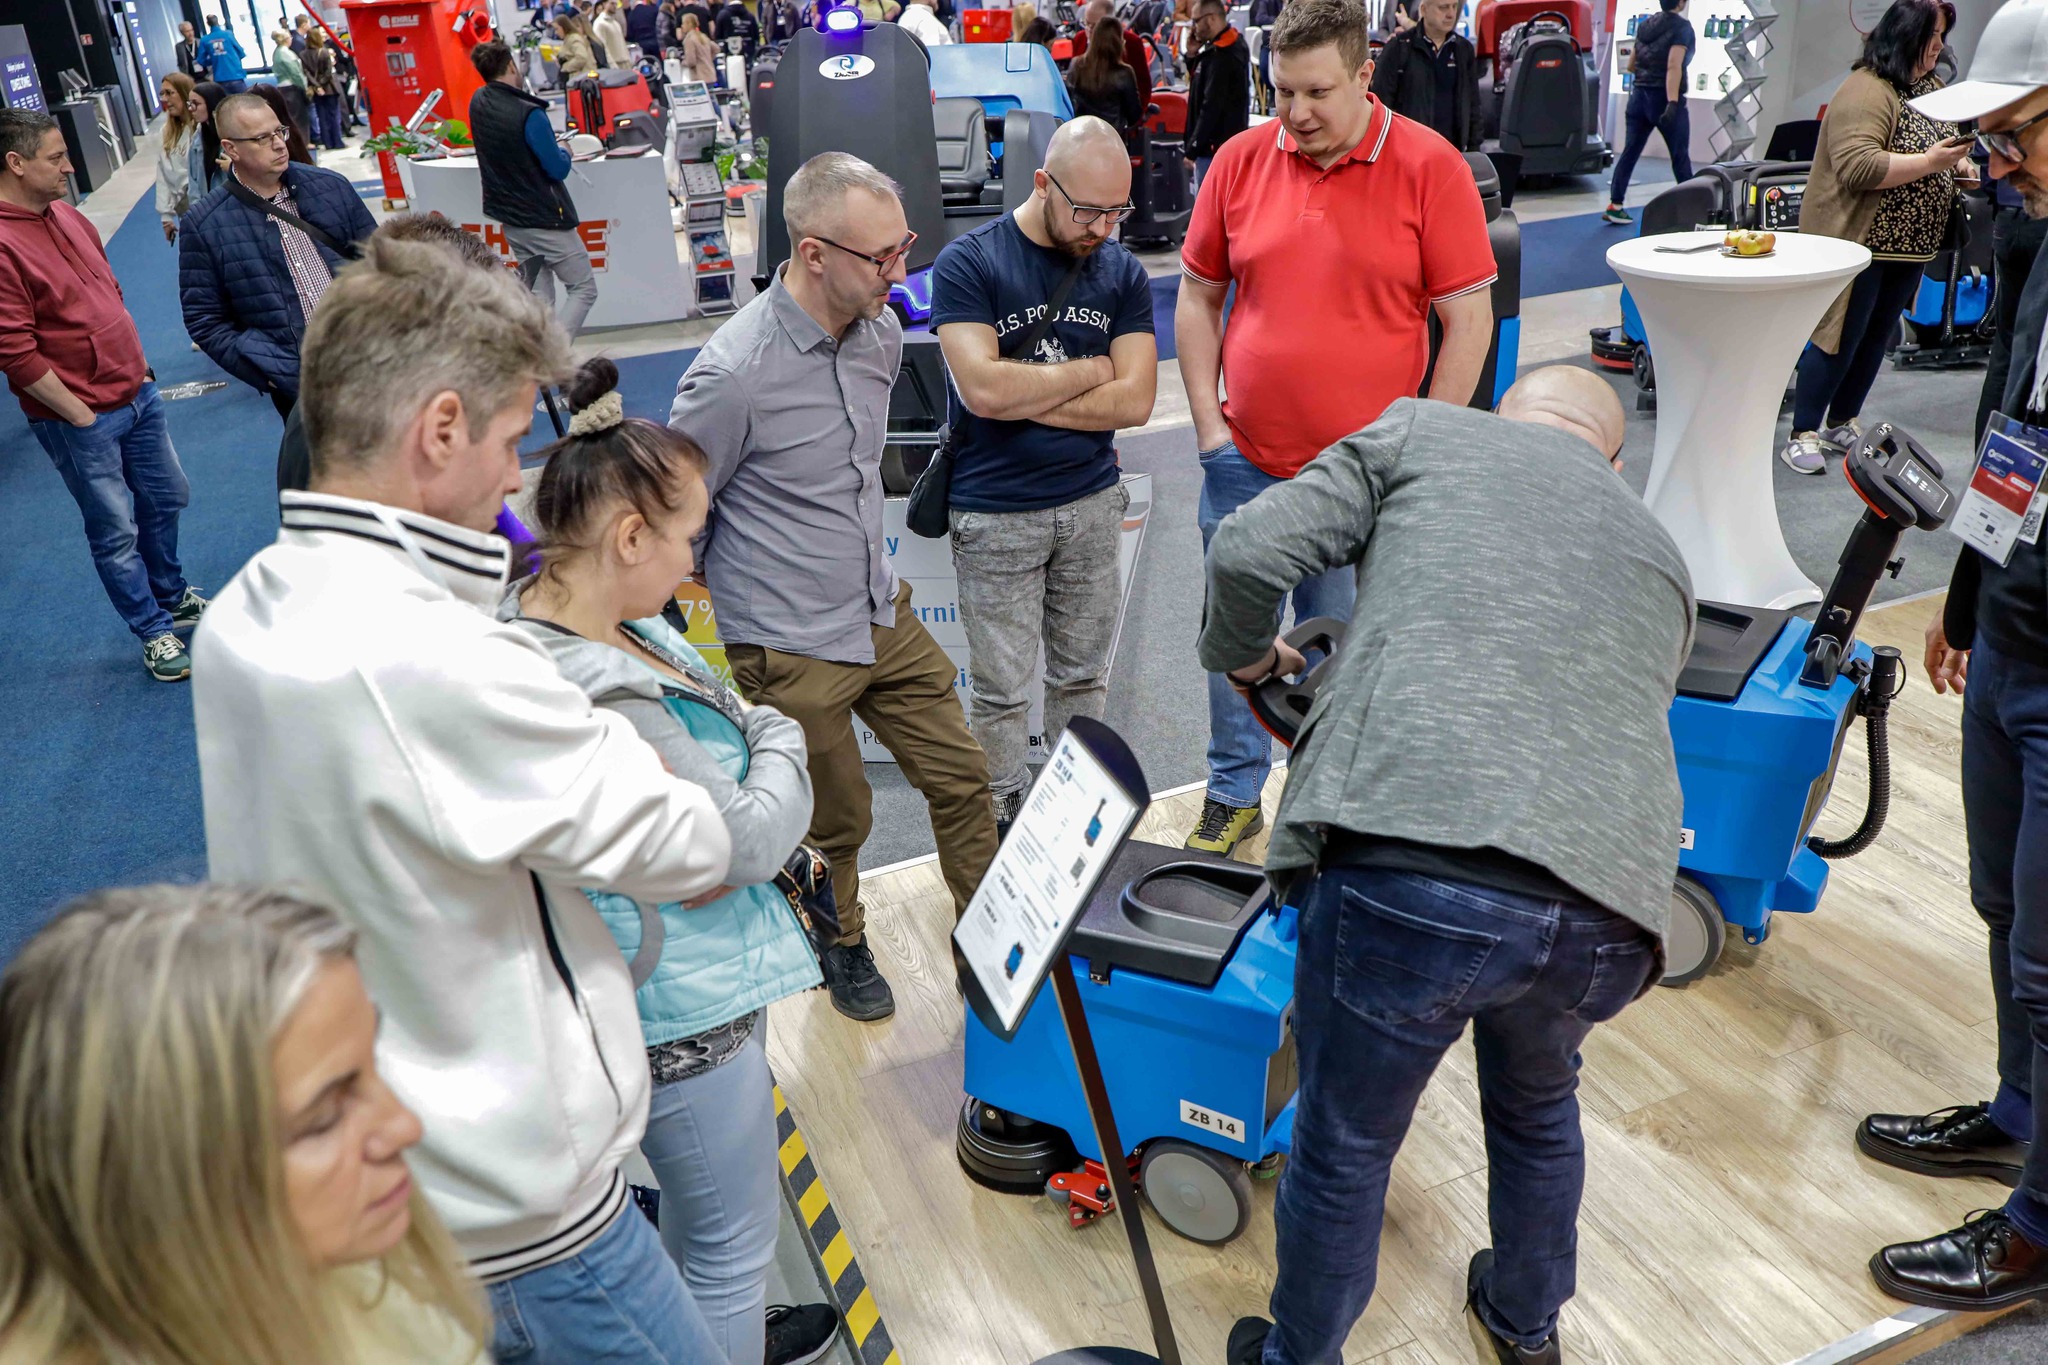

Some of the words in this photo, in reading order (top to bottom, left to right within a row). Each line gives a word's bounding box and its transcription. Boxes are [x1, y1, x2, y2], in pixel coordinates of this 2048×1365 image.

[995, 313, 1024, 337] U.S.
[1064, 306, 1111, 334] ASSN.
[1189, 1108, 1210, 1125] ZB
[1217, 1118, 1236, 1135] 14
